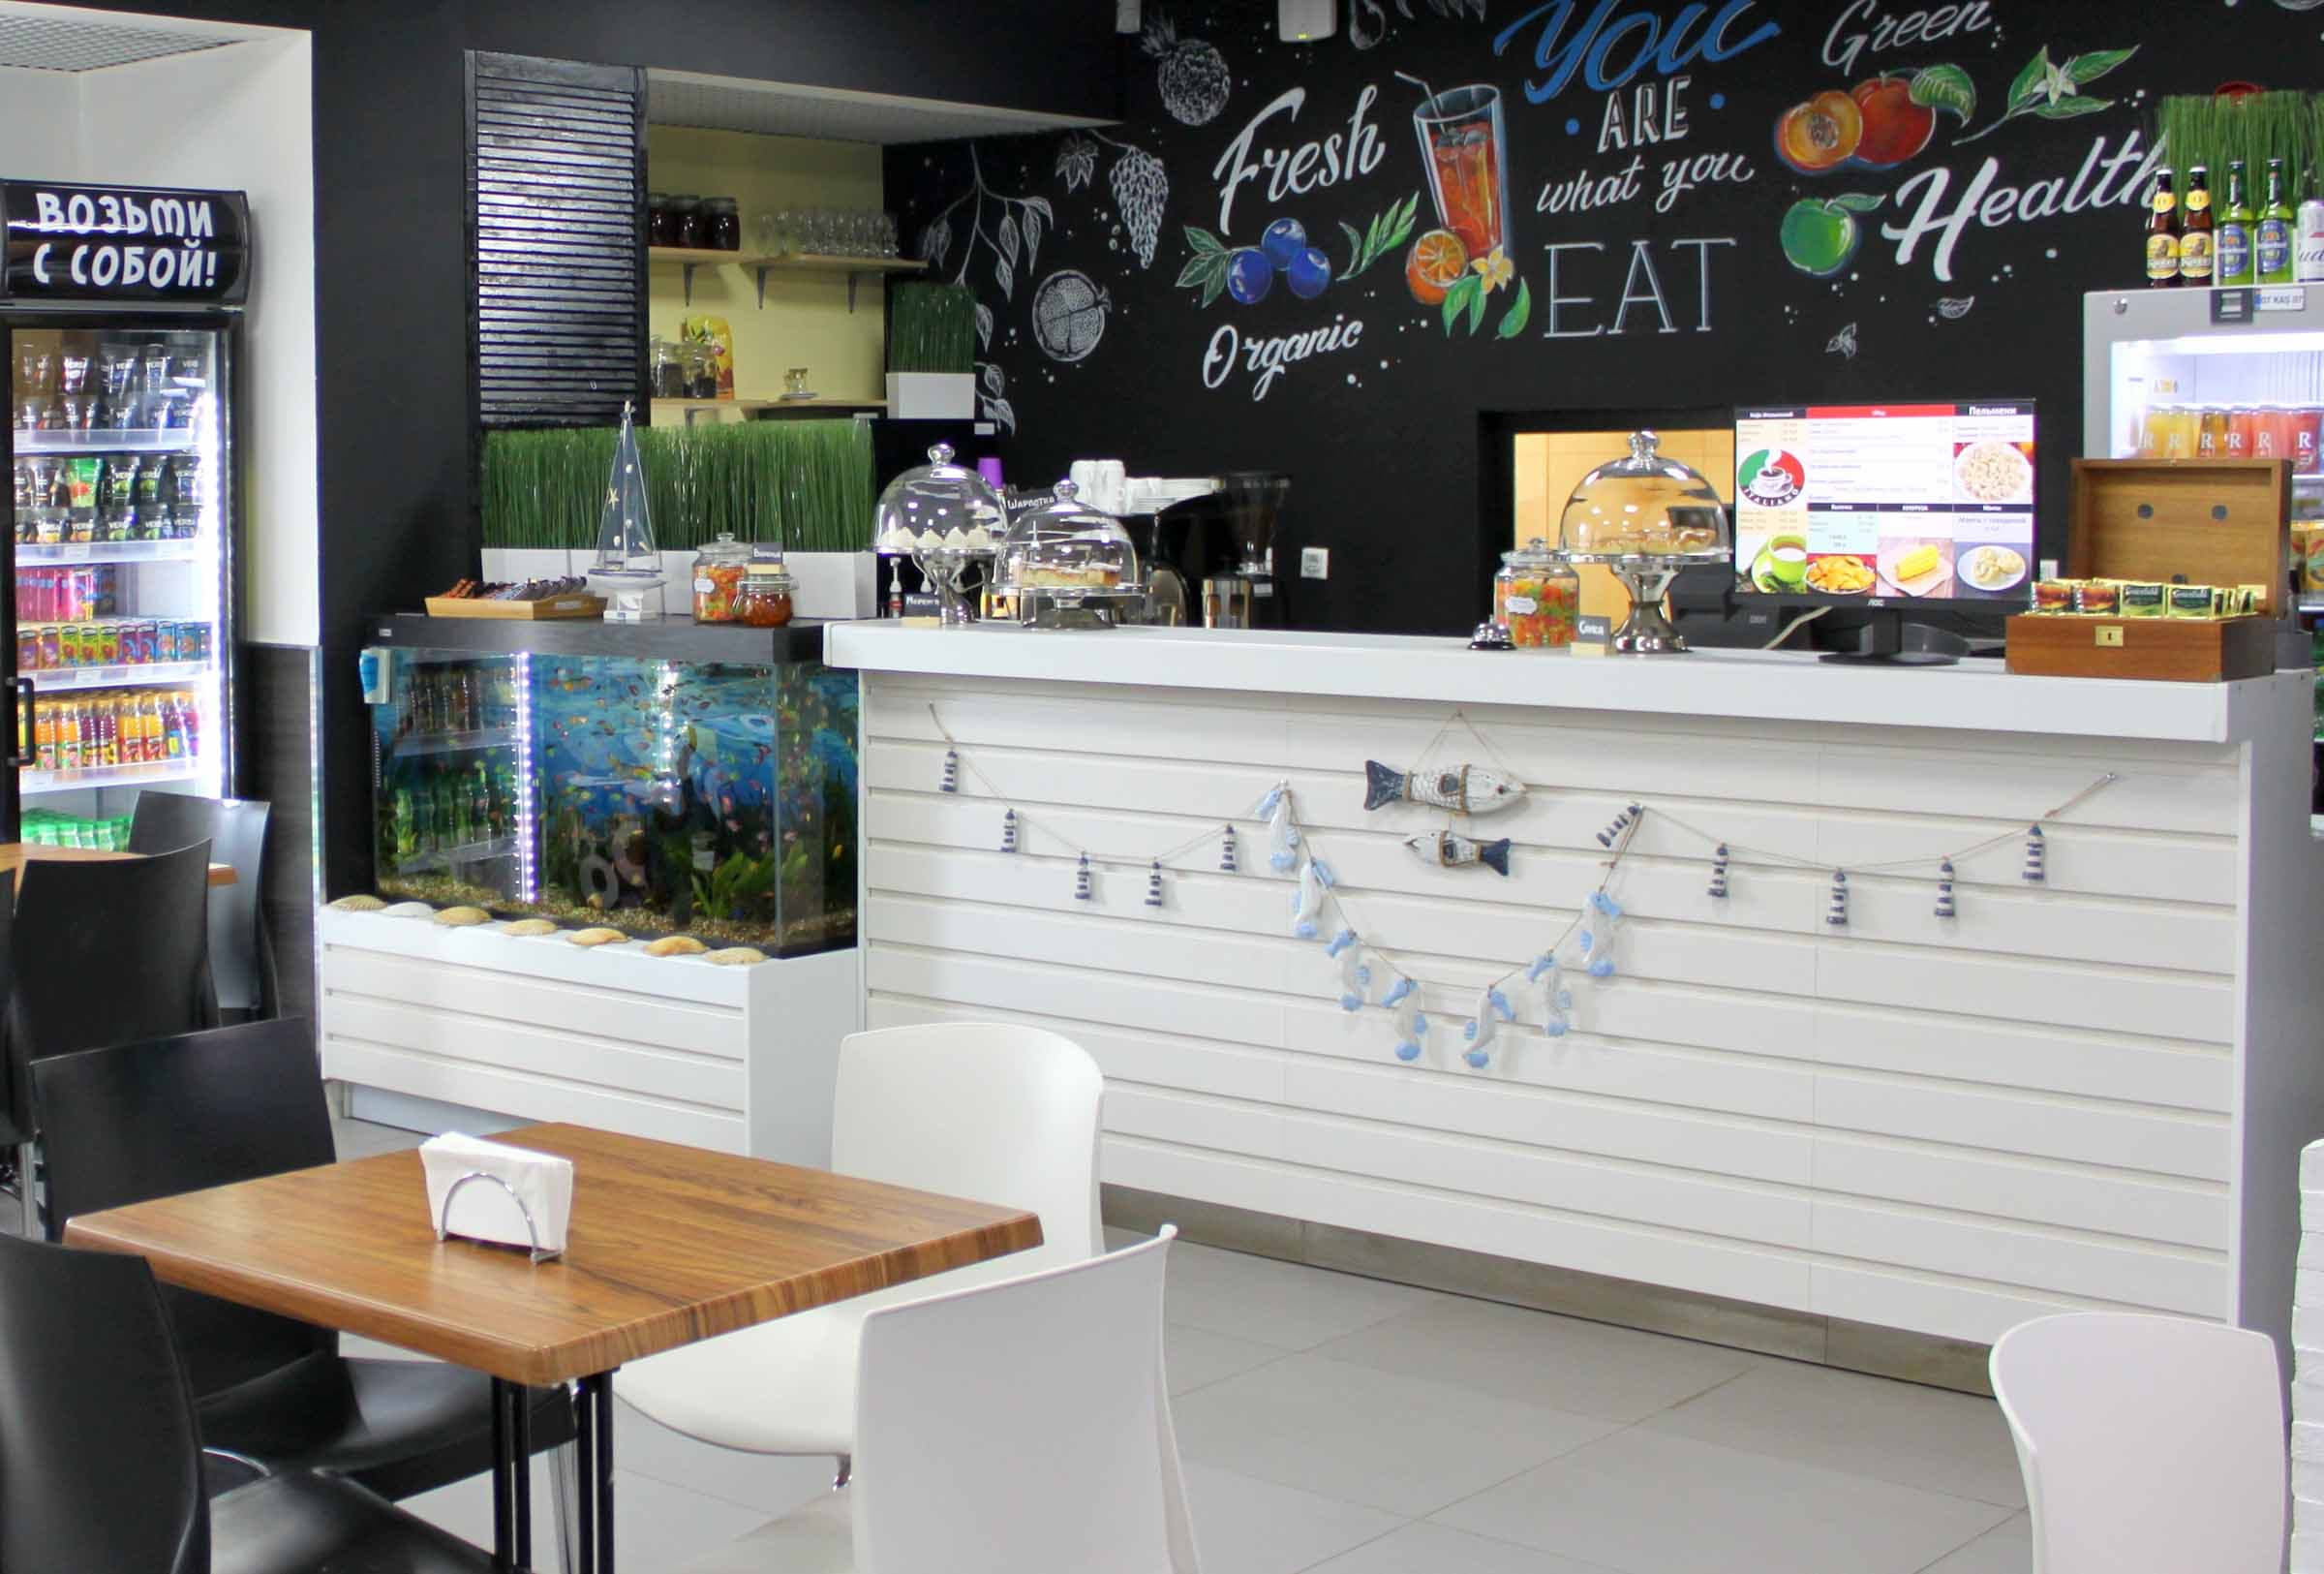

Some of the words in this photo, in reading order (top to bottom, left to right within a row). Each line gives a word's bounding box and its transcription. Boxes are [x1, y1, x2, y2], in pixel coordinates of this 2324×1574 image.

[1492, 0, 1781, 104] You
[1822, 0, 1991, 76] Green
[1598, 77, 1691, 153] ARE
[1212, 84, 1386, 236] Fresh
[1536, 155, 1641, 214] what
[1655, 152, 1756, 213] you
[35, 192, 214, 237] ВОЗЬМИ
[33, 242, 51, 285] С
[70, 237, 218, 288] СОБОЙ!
[1544, 237, 1736, 338] EAT
[1203, 320, 1363, 402] Organic
[2201, 434, 2213, 448] R
[2230, 433, 2242, 448] R
[2259, 433, 2272, 448] R
[2299, 432, 2311, 448] R
